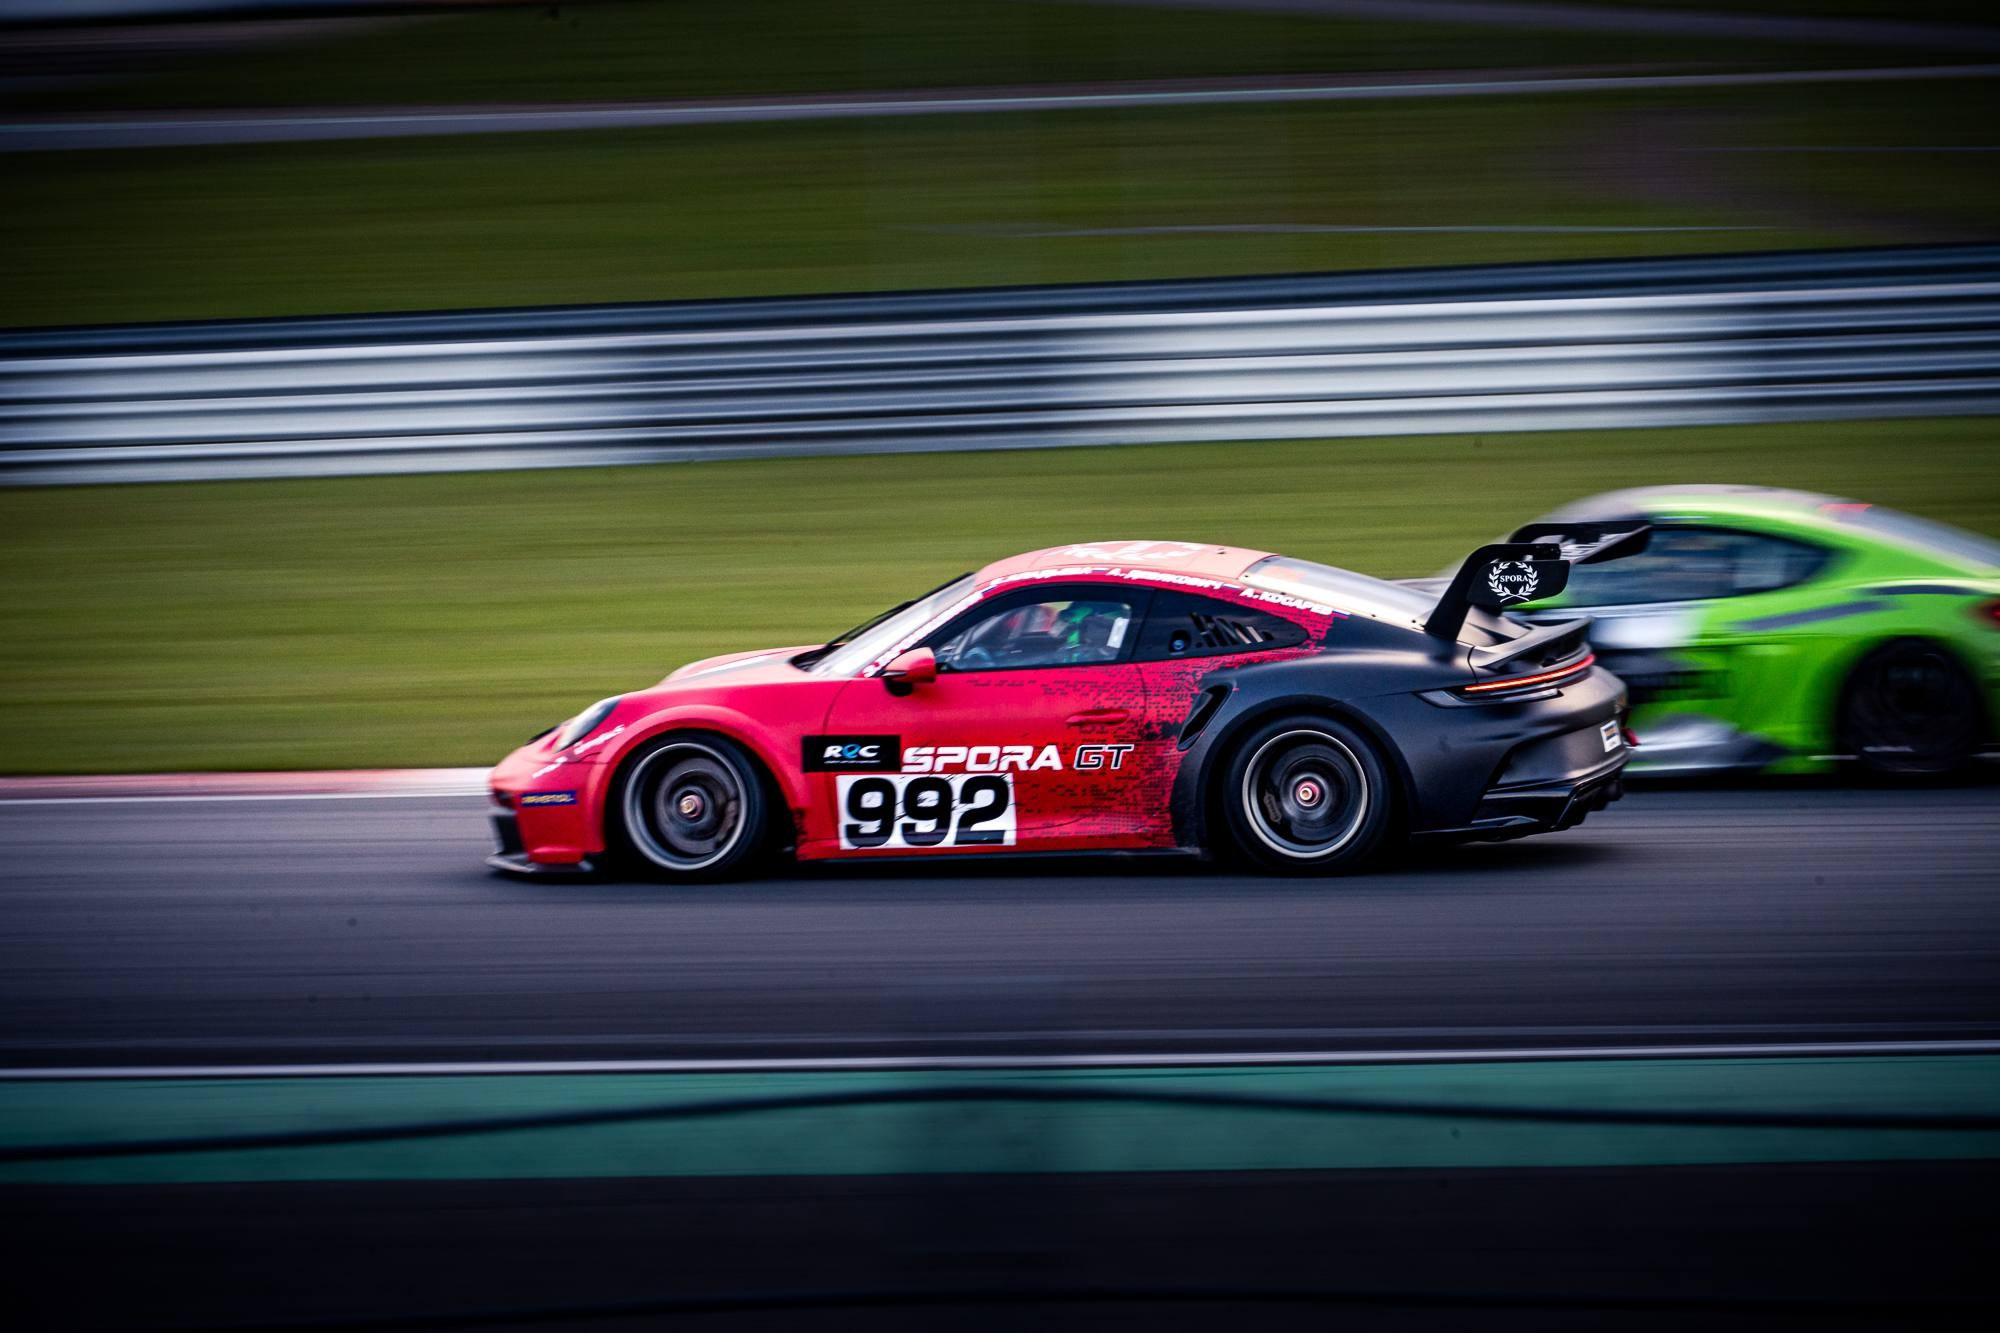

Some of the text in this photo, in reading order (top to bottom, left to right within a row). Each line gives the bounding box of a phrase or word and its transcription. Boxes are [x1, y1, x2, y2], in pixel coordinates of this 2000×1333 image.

[1499, 574, 1529, 582] SPORA
[901, 744, 1135, 773] SPORA GT
[845, 775, 1010, 847] 992
